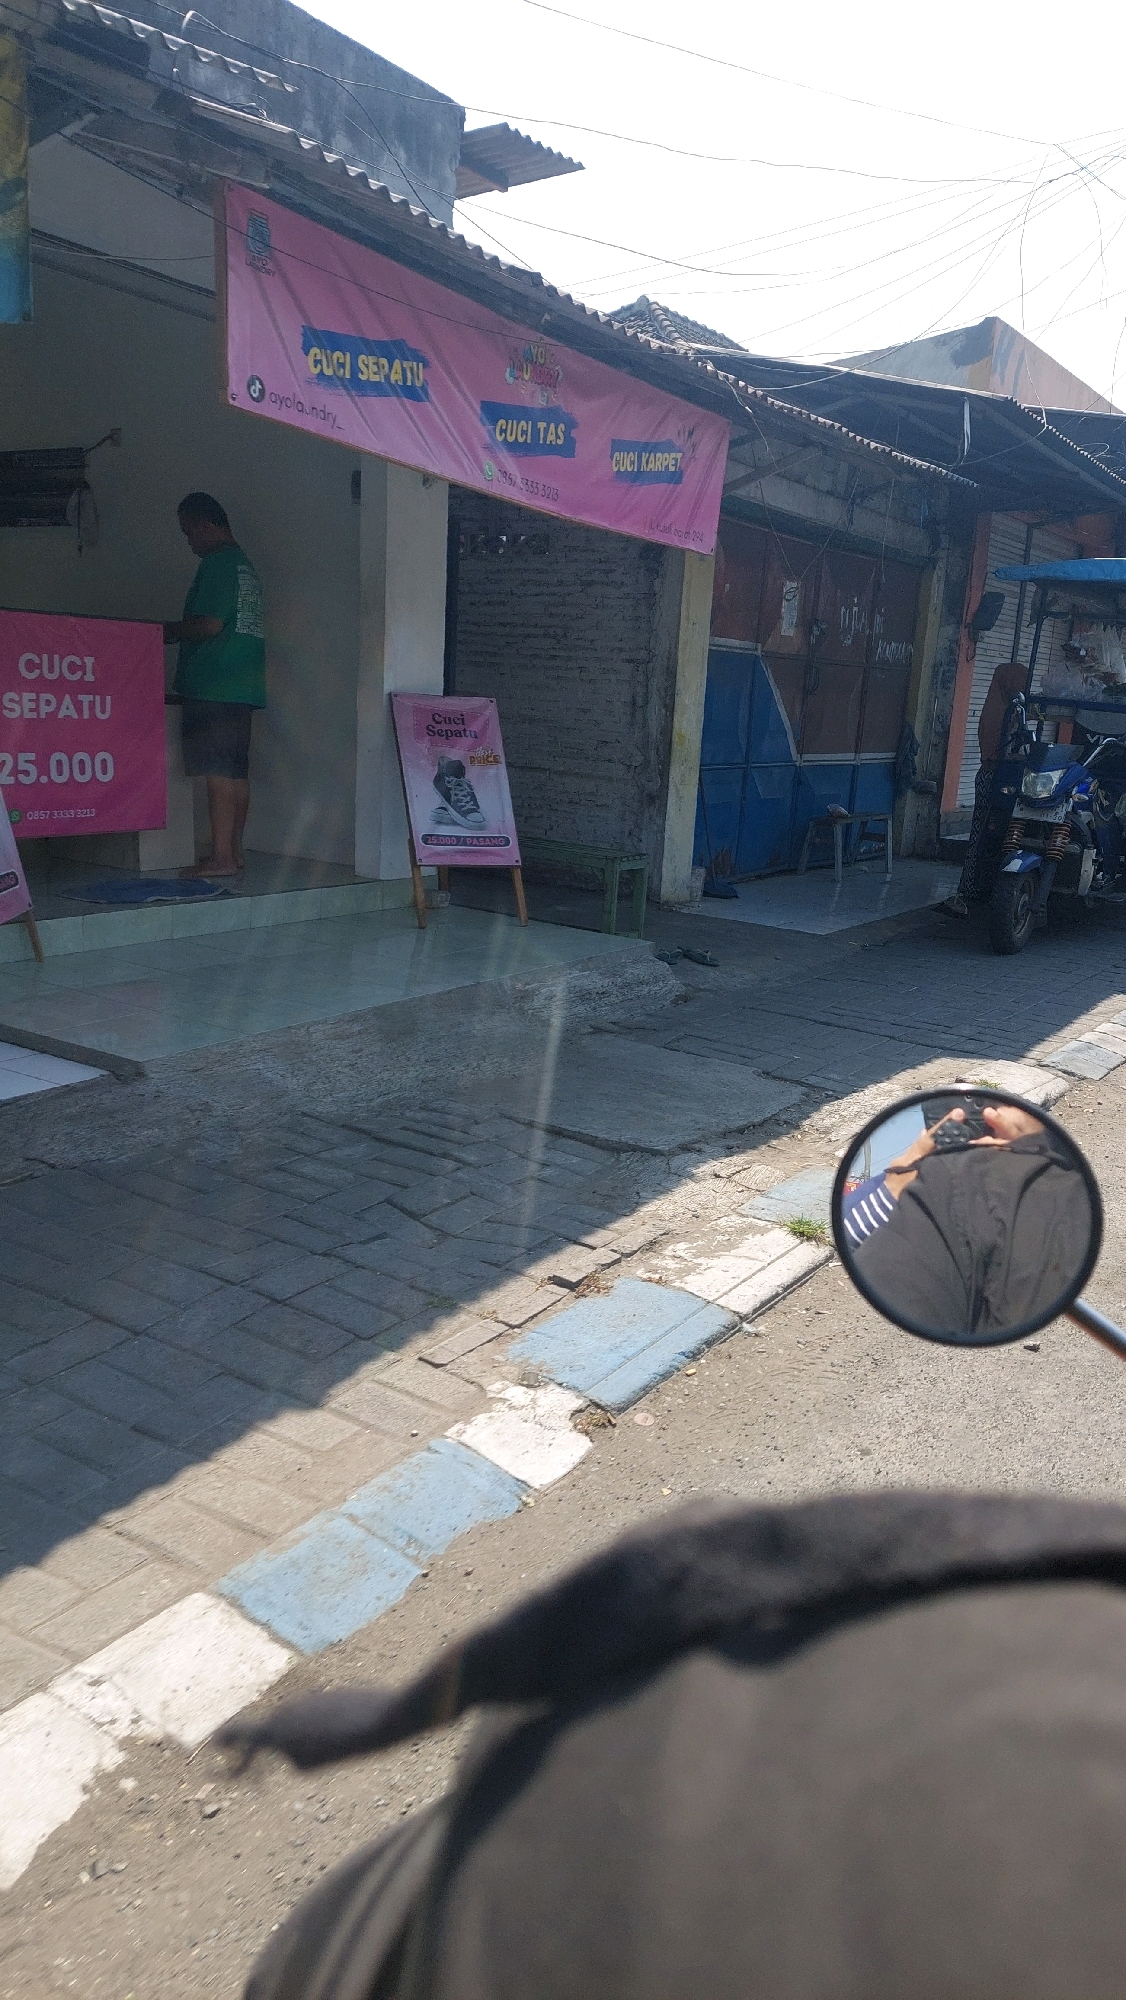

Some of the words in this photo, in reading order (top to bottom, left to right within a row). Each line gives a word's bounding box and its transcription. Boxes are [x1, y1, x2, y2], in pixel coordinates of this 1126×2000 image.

[307, 346, 351, 379] CUCI
[357, 354, 424, 387] SEPATU
[495, 418, 532, 443] CUCI
[537, 421, 566, 445] TAS
[612, 451, 637, 472] CUCI
[641, 452, 683, 472] KARPET
[18, 652, 95, 682] CUCI
[2, 691, 112, 720] SEPATU
[431, 712, 466, 726] Cuci
[426, 724, 478, 740] Sepatu
[26, 811, 50, 820] 0857
[76, 808, 96, 818] 3213
[426, 835, 457, 845] 25.000
[466, 837, 505, 846] PASANG
